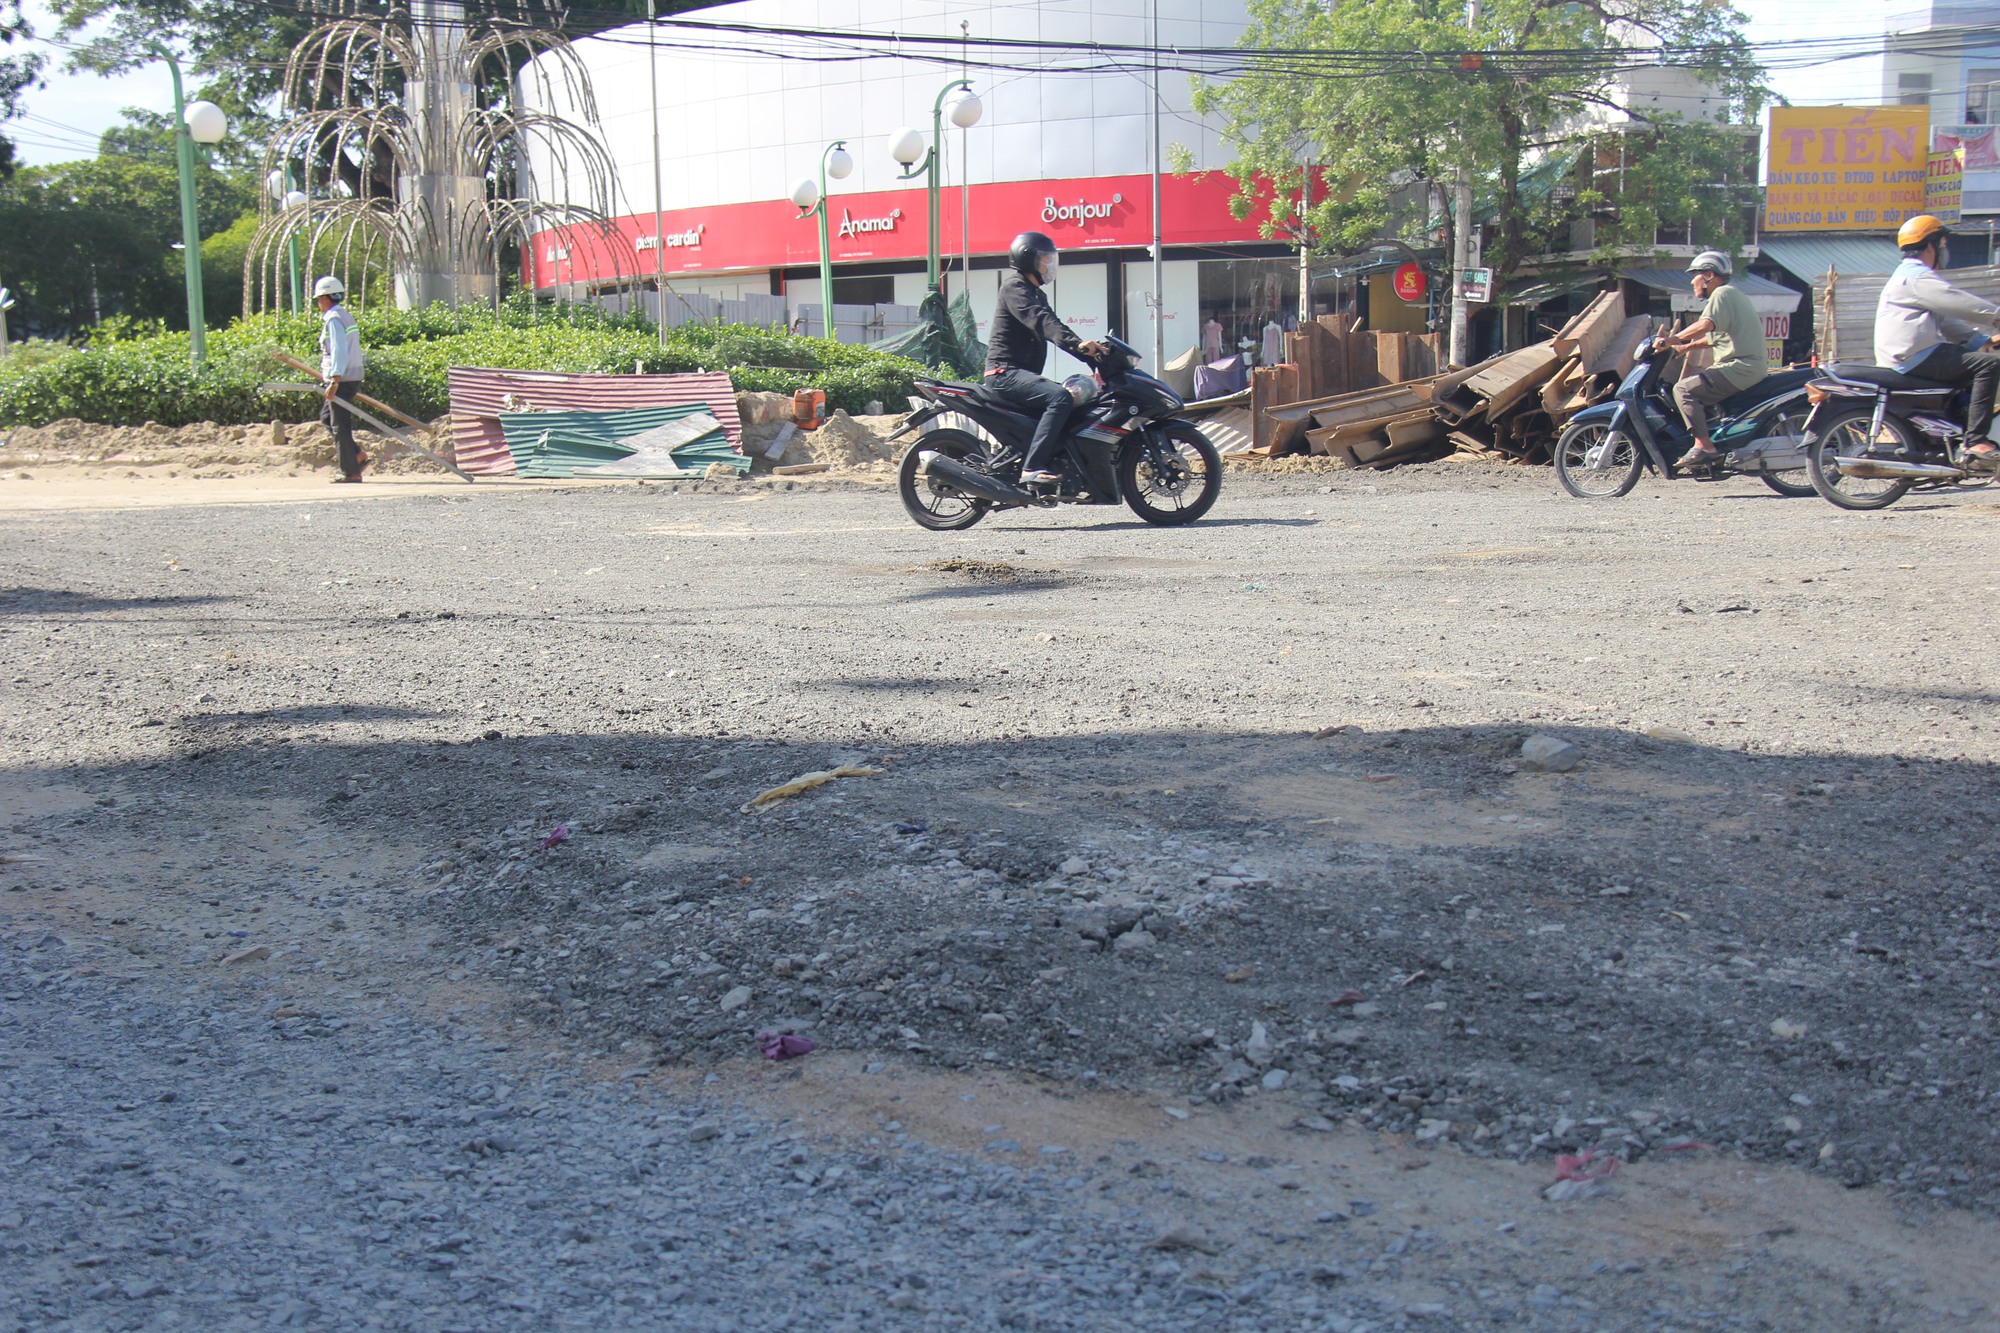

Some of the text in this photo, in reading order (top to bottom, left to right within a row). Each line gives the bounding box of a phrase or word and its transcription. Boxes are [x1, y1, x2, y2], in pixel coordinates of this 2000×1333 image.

[1780, 108, 1919, 165] TIẾN
[1795, 171, 1819, 184] KEO
[1822, 171, 1837, 184] XE
[1883, 170, 1926, 183] LAPTOP
[1890, 189, 1922, 203] DECAL
[838, 208, 894, 238] Anamai
[1042, 197, 1113, 227] Bonjour
[1769, 207, 1801, 226] QUẢNG
[1803, 208, 1822, 224] CÁO
[635, 229, 700, 254] pierr cardin
